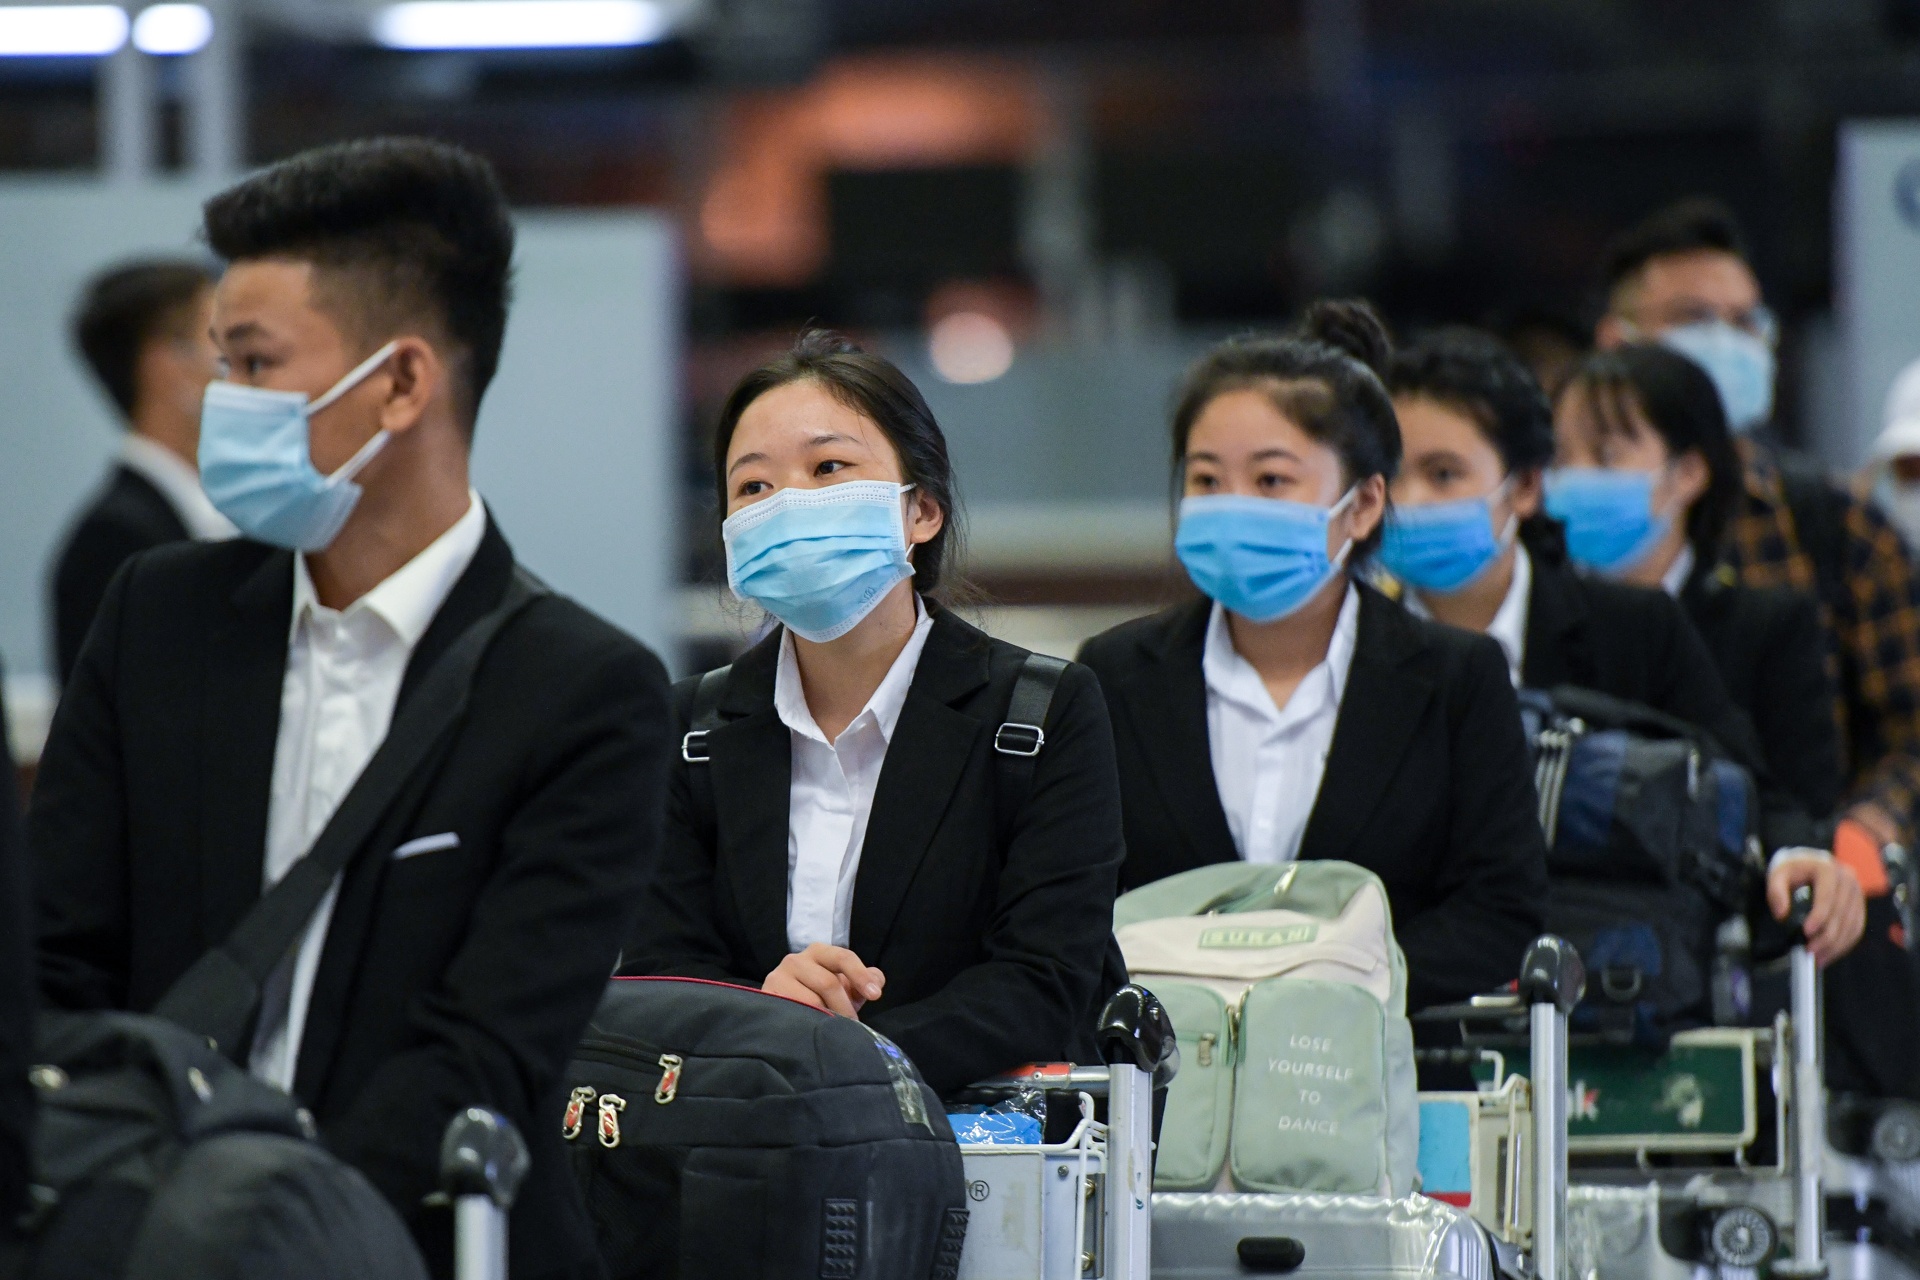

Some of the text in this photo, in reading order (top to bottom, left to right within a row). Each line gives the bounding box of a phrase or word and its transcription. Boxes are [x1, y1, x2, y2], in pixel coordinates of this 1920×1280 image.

[1289, 1033, 1332, 1052] LOSE
[1268, 1057, 1354, 1081] YOURSELF
[1299, 1089, 1321, 1104] TO
[1278, 1115, 1339, 1136] DANCE
